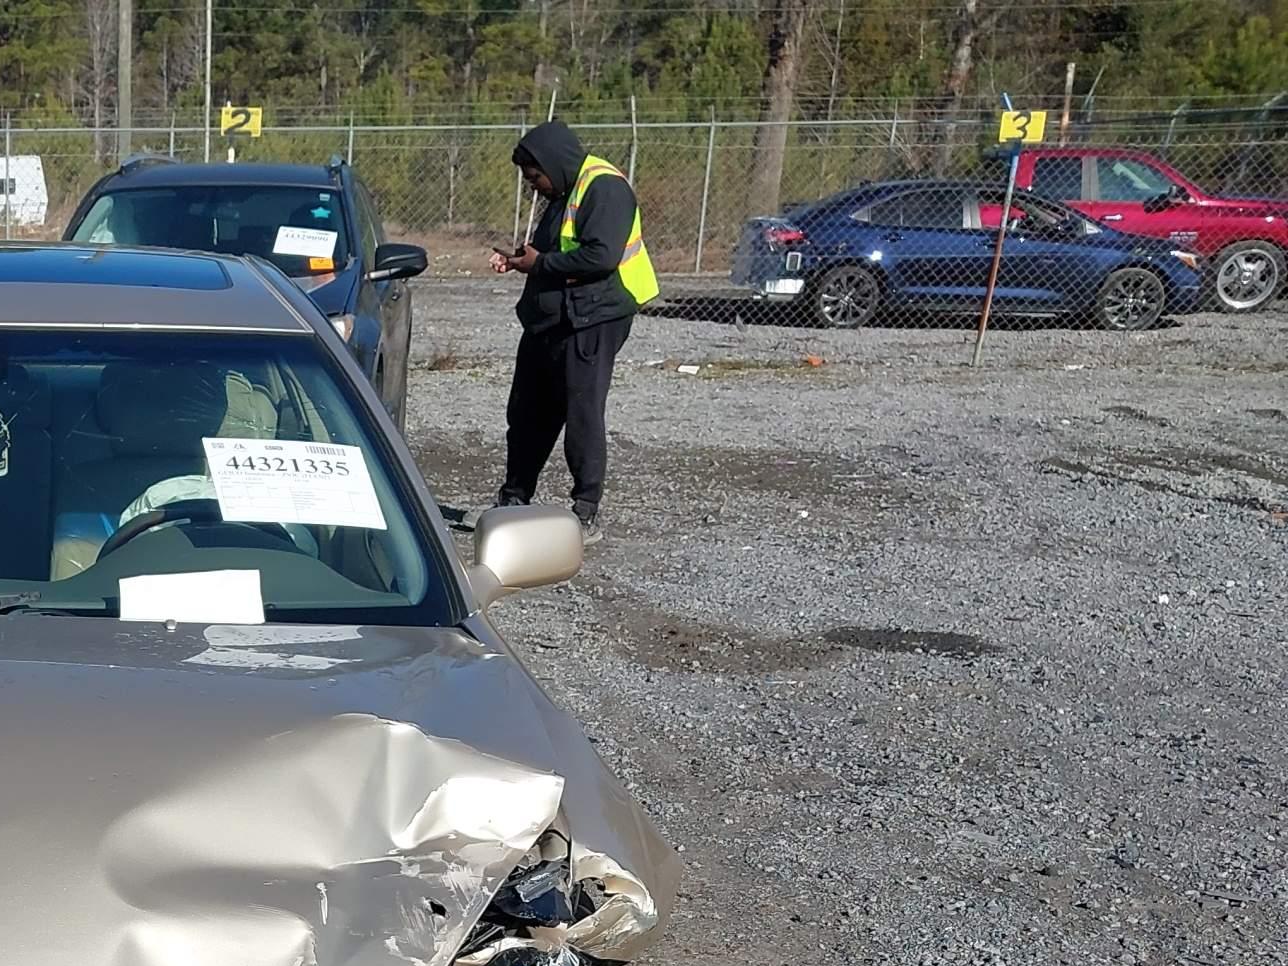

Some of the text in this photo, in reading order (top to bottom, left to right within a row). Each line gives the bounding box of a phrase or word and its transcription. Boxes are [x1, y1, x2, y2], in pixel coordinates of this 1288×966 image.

[223, 109, 252, 135] 2
[1005, 111, 1032, 142] 3
[225, 455, 350, 477] 44321335
